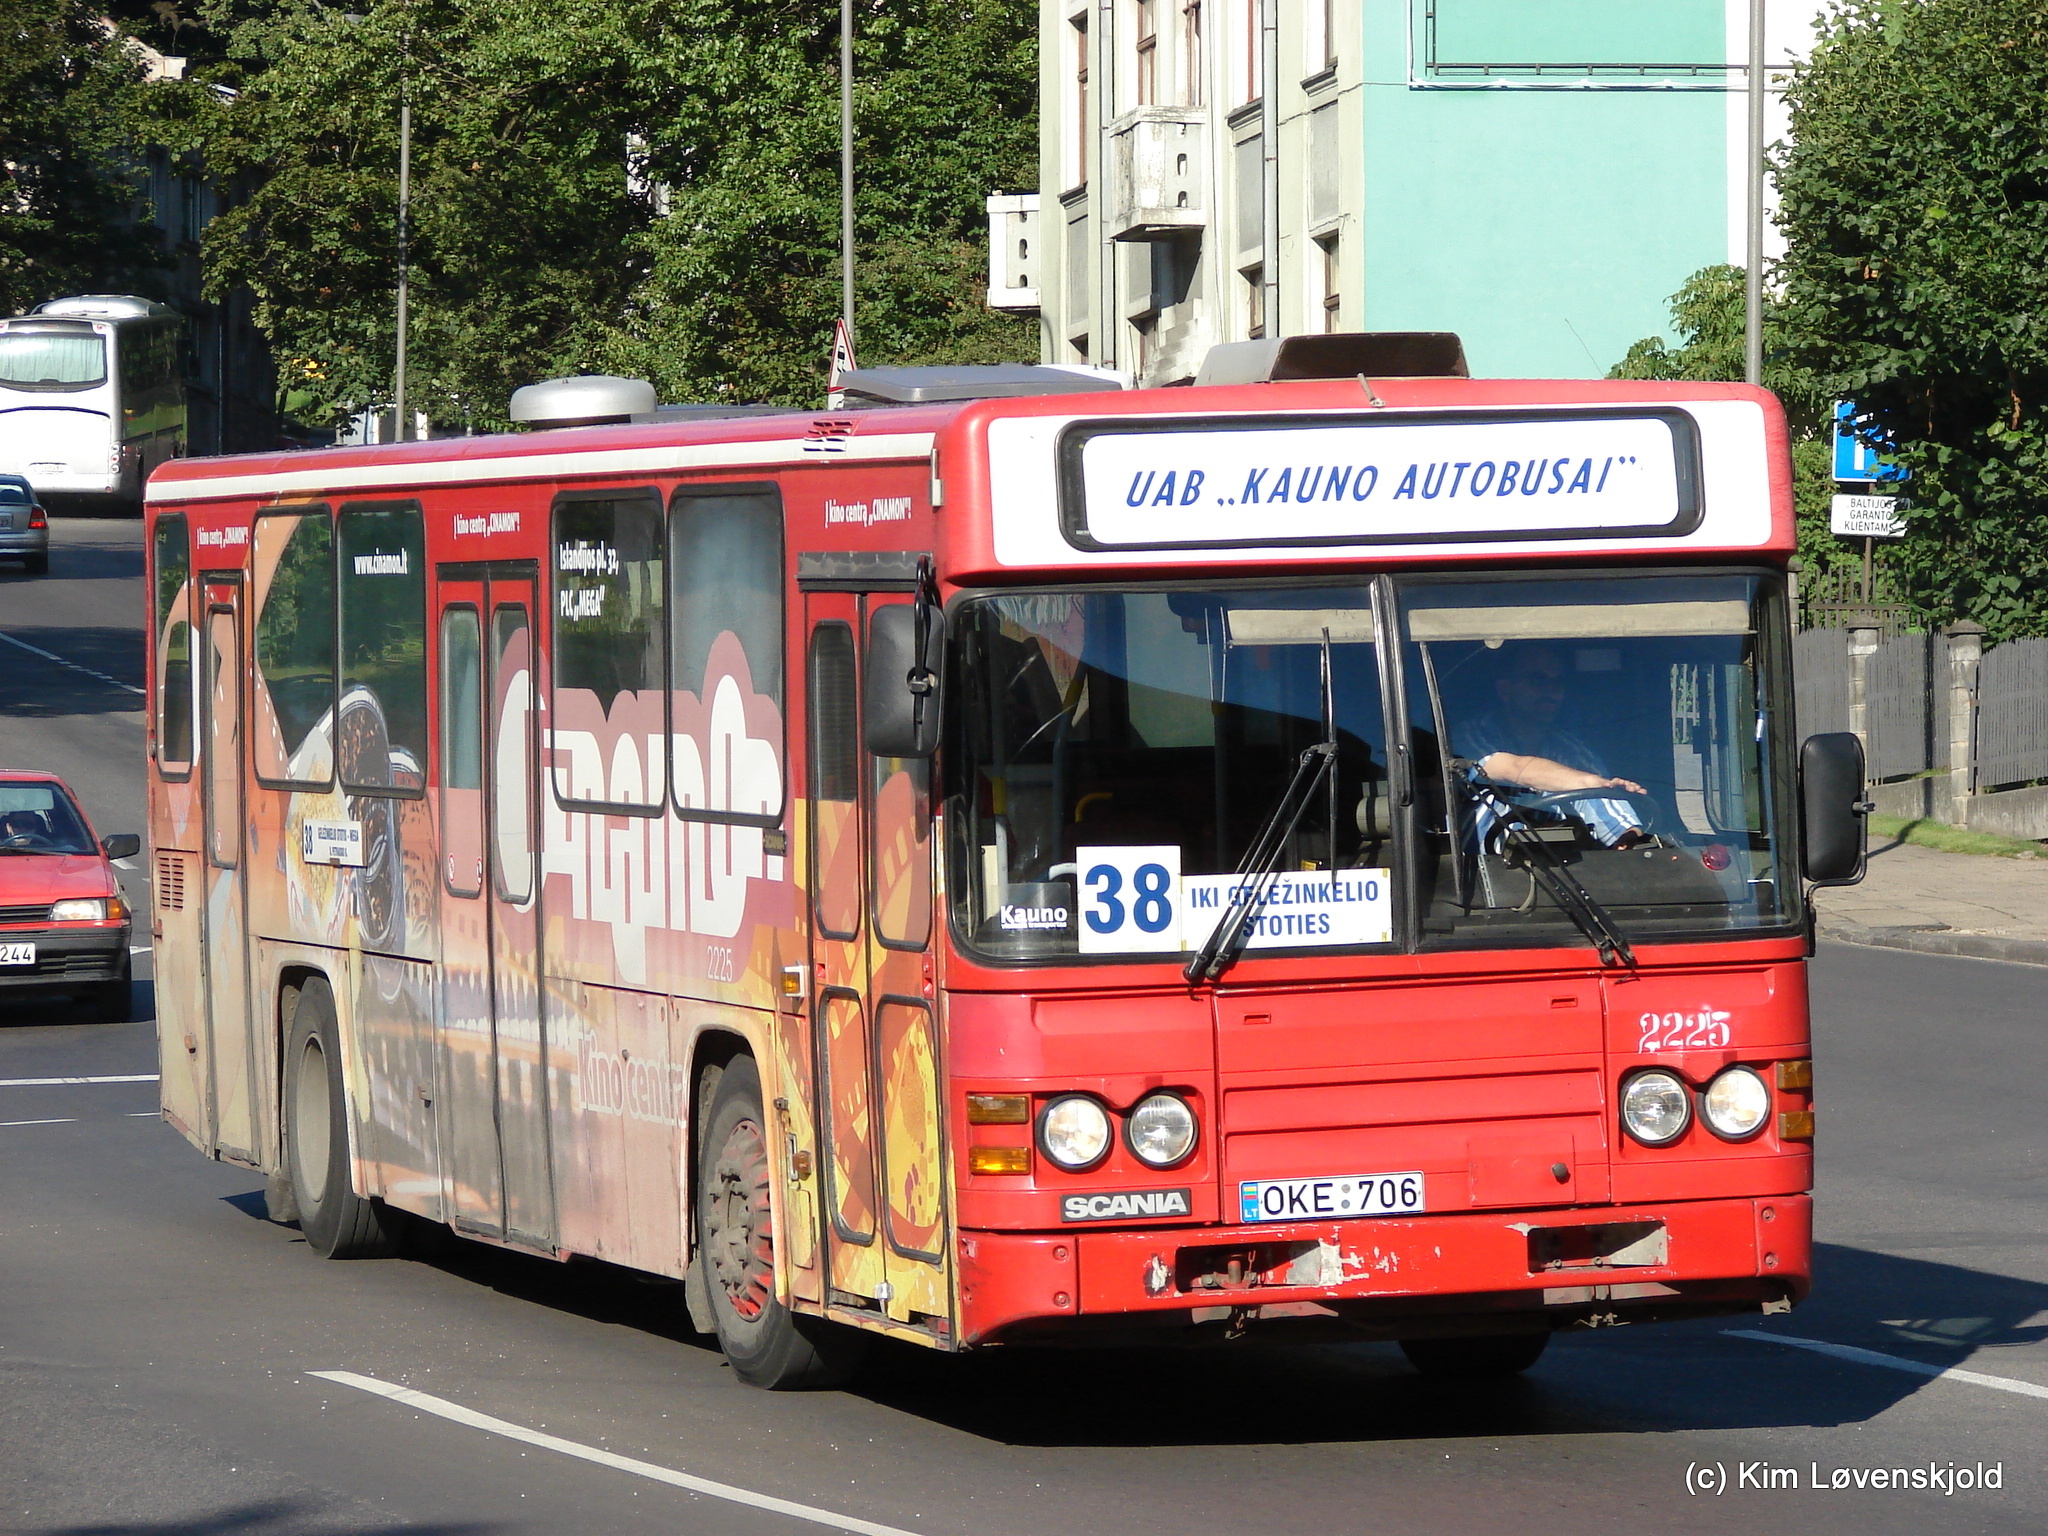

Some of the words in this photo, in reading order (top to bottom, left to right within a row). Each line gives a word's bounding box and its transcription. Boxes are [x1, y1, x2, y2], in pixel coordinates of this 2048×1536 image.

[1126, 469, 1205, 508] UAB
[829, 498, 845, 523] kino
[354, 547, 408, 575] www.cinamon.lt
[559, 540, 596, 577] Islandijos
[596, 540, 607, 577] pl.
[560, 589, 574, 617] PLC
[1085, 863, 1172, 934] 38
[1191, 886, 1219, 909] IKI
[1000, 904, 1068, 925] Kauno
[1242, 912, 1330, 938] STOTIES
[707, 945, 733, 982] 2225
[1638, 1009, 1731, 1054] 2225
[1064, 1192, 1188, 1219] SCANIA
[1244, 1208, 1258, 1218] LT
